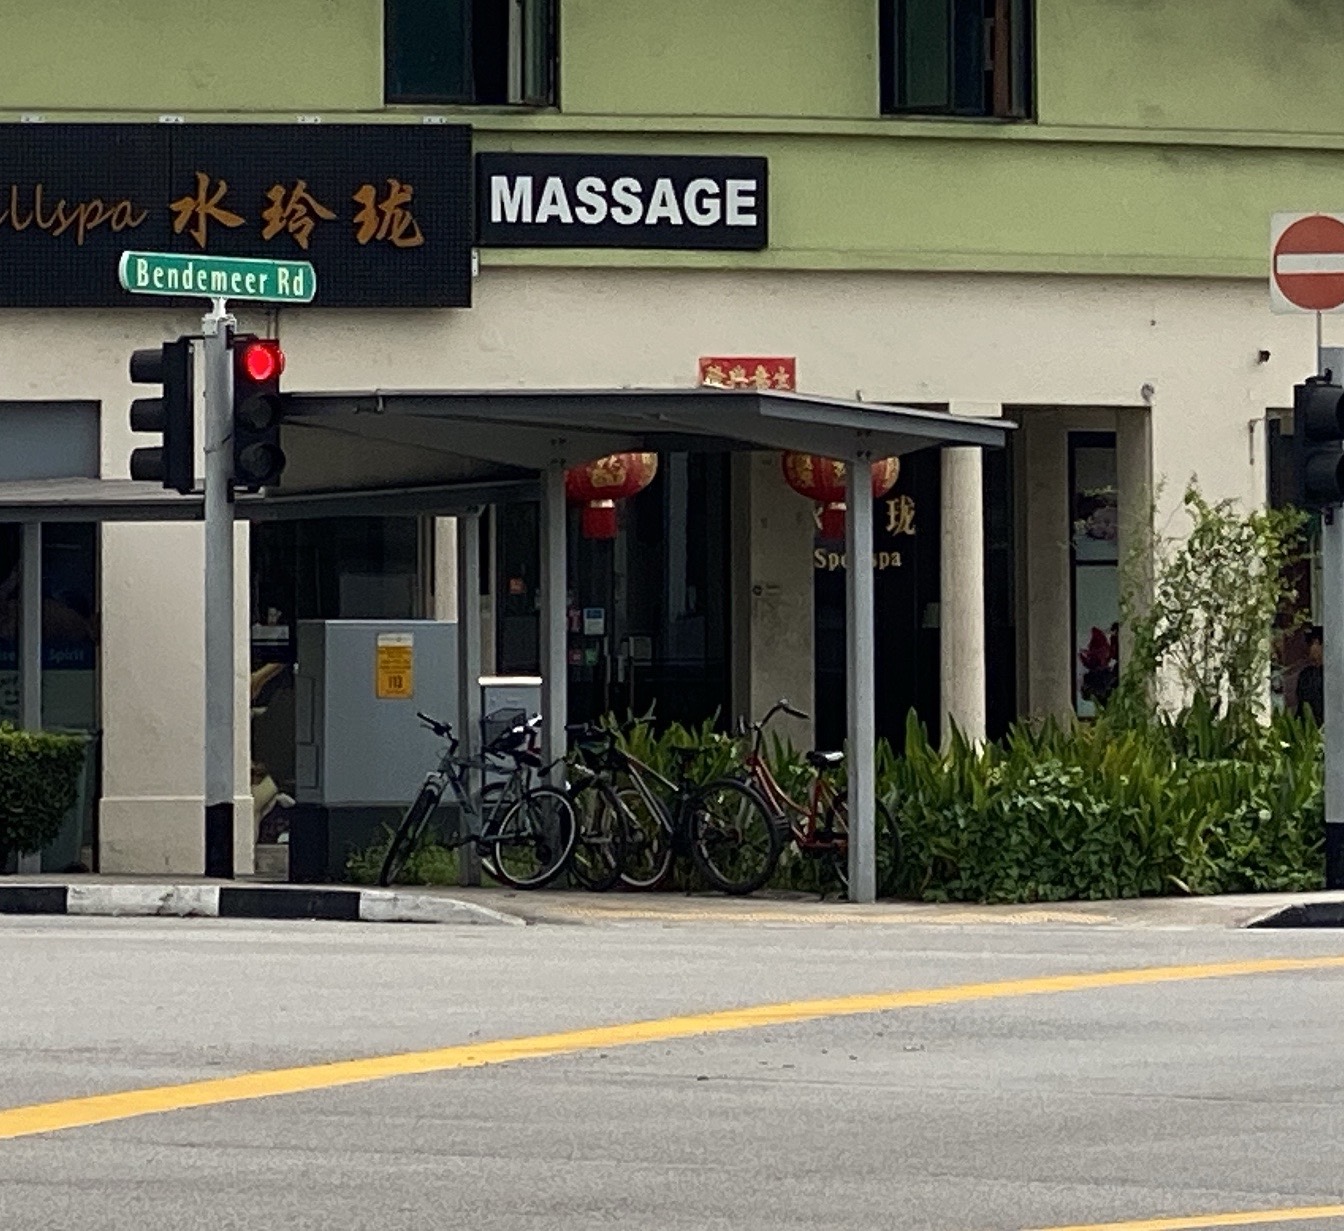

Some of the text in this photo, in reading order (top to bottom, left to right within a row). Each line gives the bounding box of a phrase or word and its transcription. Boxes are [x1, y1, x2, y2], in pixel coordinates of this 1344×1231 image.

[489, 175, 758, 227] MASSAGE
[135, 257, 305, 296] Bendemeer Rd
